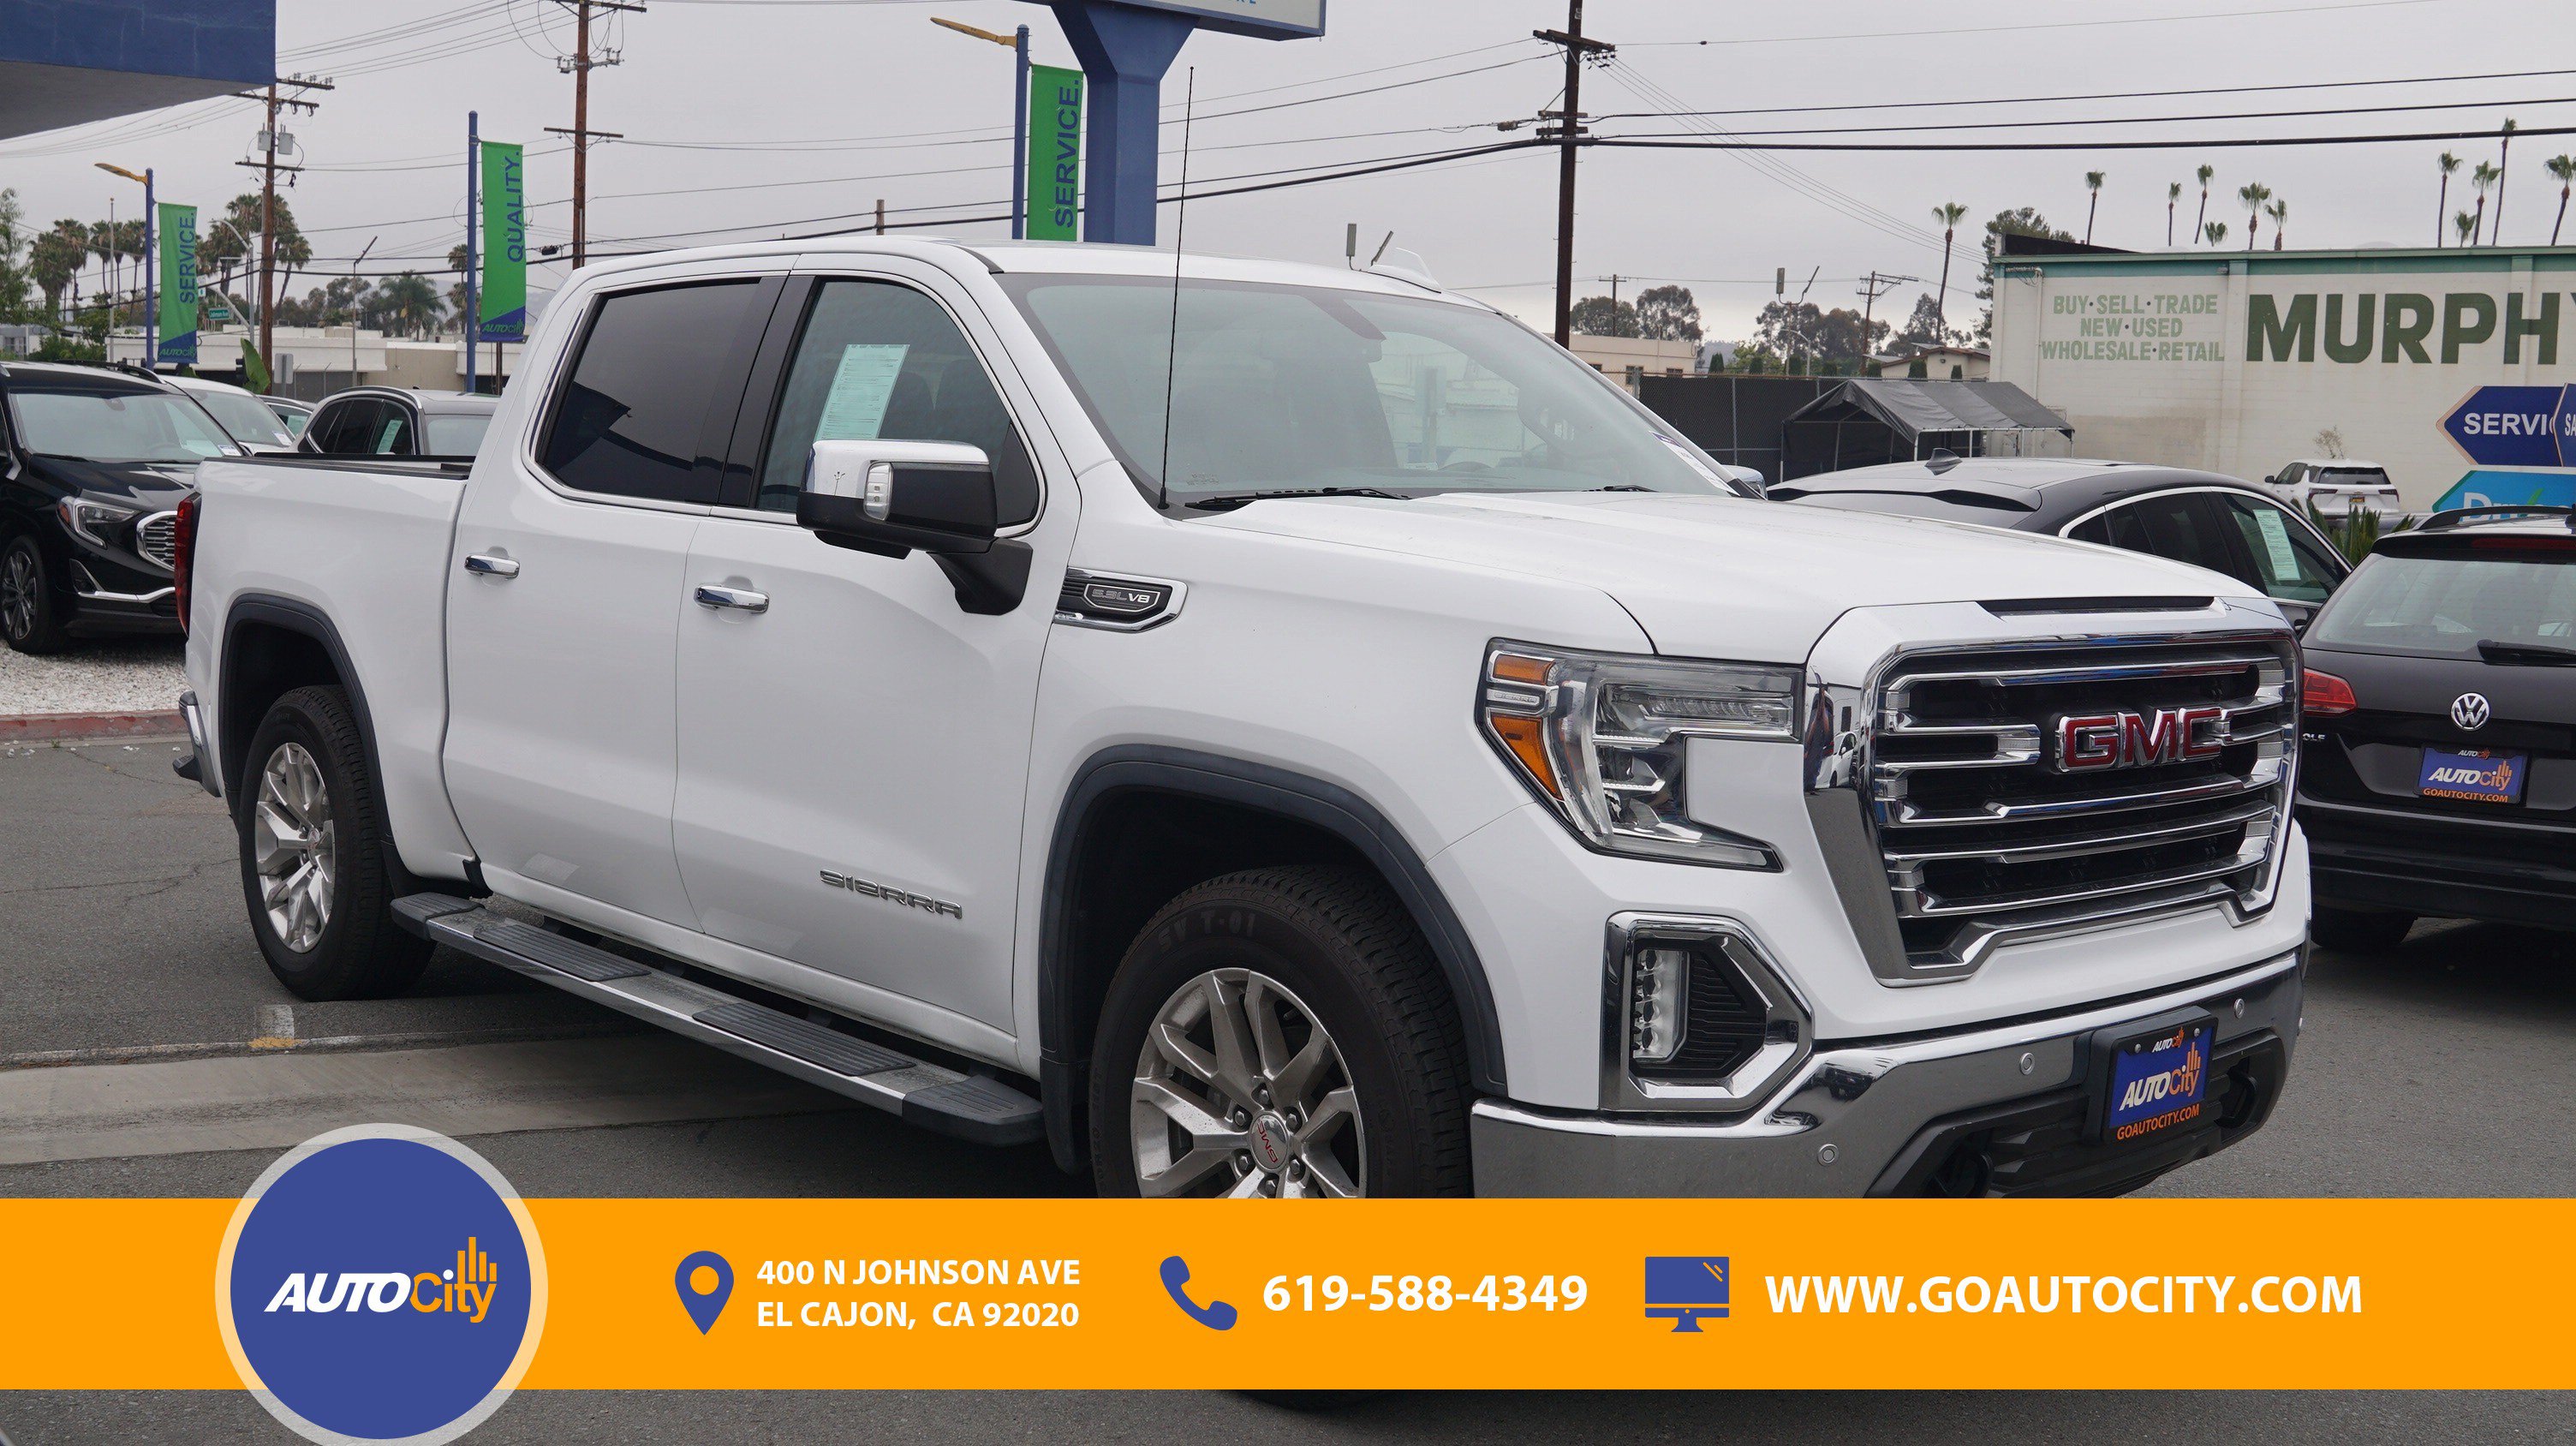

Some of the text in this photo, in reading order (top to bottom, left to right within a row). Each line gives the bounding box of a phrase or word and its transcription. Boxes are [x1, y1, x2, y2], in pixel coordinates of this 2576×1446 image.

[2053, 294, 2218, 314] BUY SELL TRADE
[2080, 318, 2183, 338] NEW USED
[2246, 292, 2576, 365] MURPH
[2042, 340, 2225, 362] WHOLESALE RETAIL
[2463, 412, 2553, 436] SERVI
[2056, 706, 2224, 773] GMC
[2423, 786, 2509, 804] GOAUTOCITY.COM
[820, 869, 963, 920] SIERRA
[2116, 1102, 2200, 1141] GOAUTOCITY.COM
